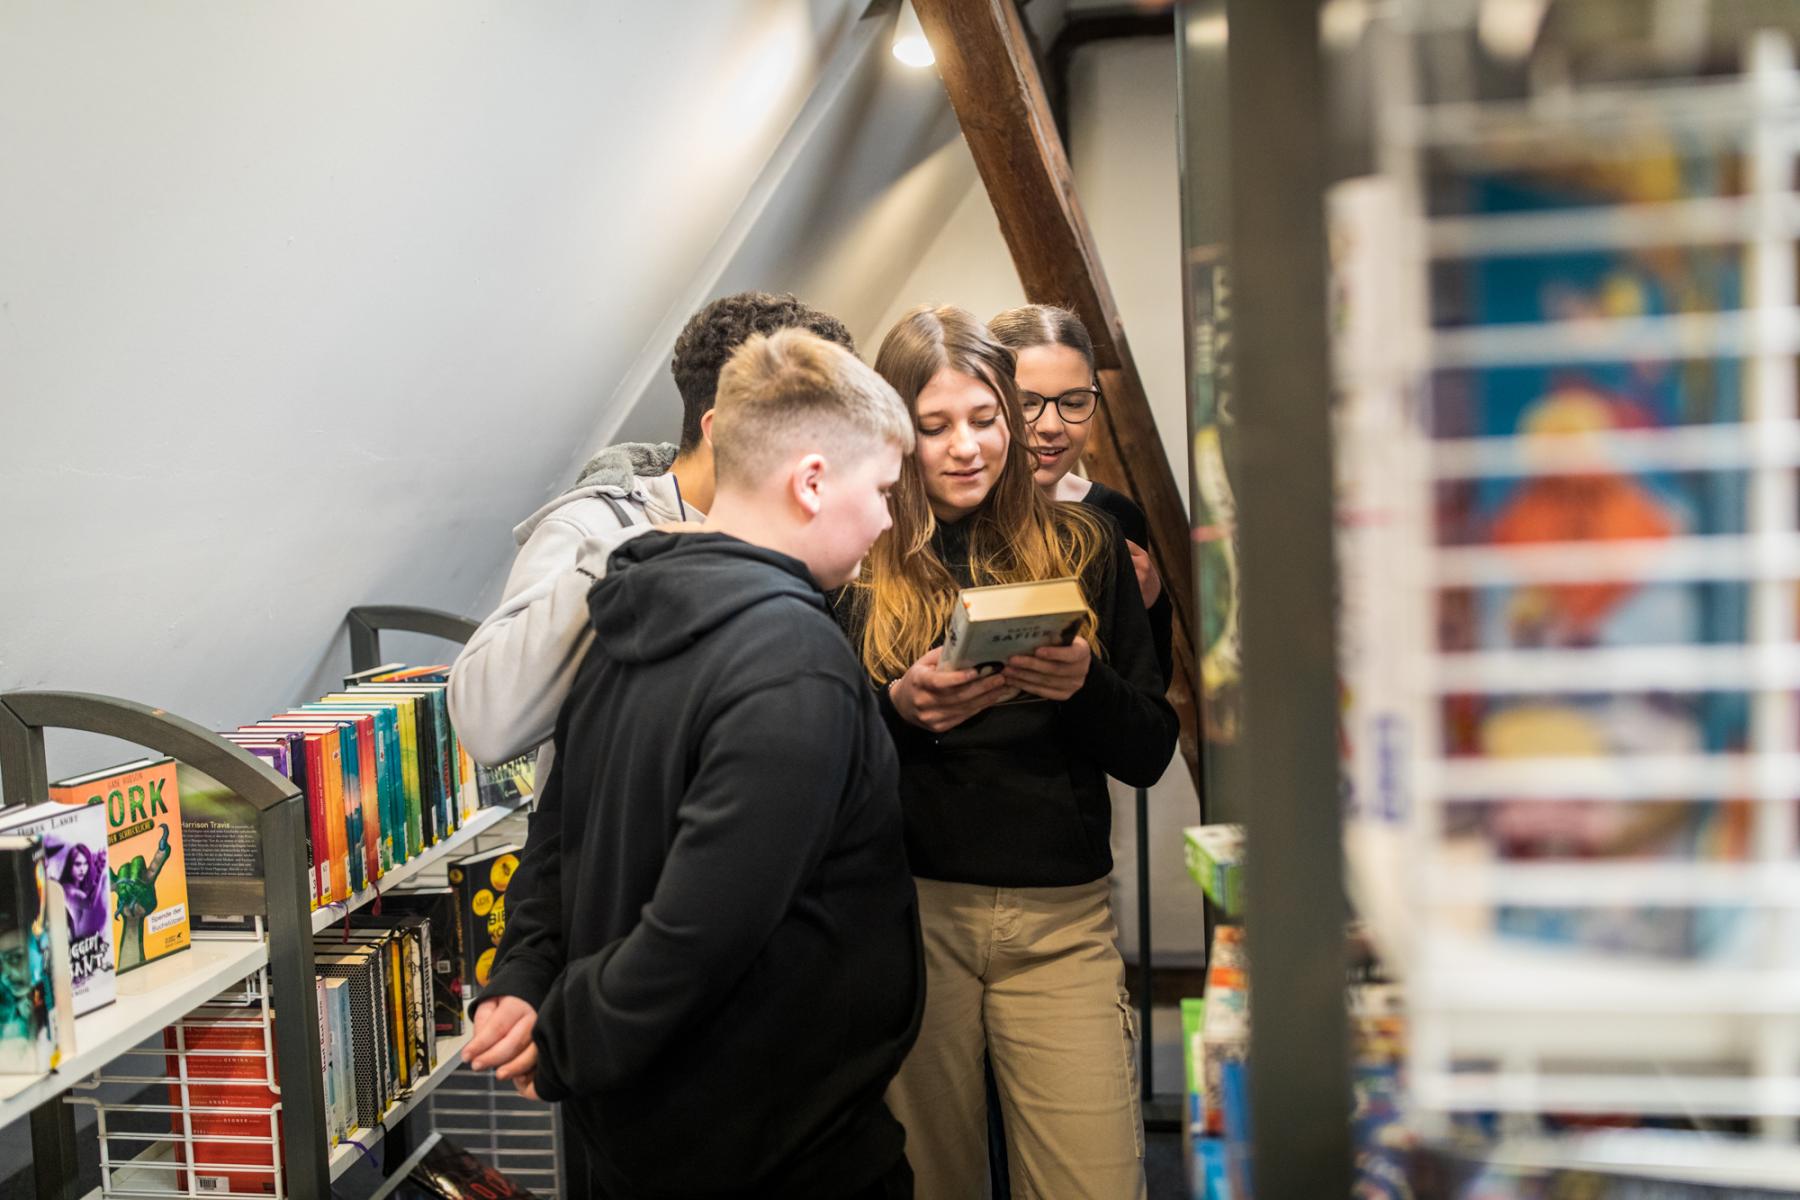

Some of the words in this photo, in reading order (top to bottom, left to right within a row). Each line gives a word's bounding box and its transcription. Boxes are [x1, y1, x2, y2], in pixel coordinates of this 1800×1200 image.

[991, 630, 1052, 643] SAFIER
[88, 778, 168, 828] ORK
[210, 821, 230, 829] Travis
